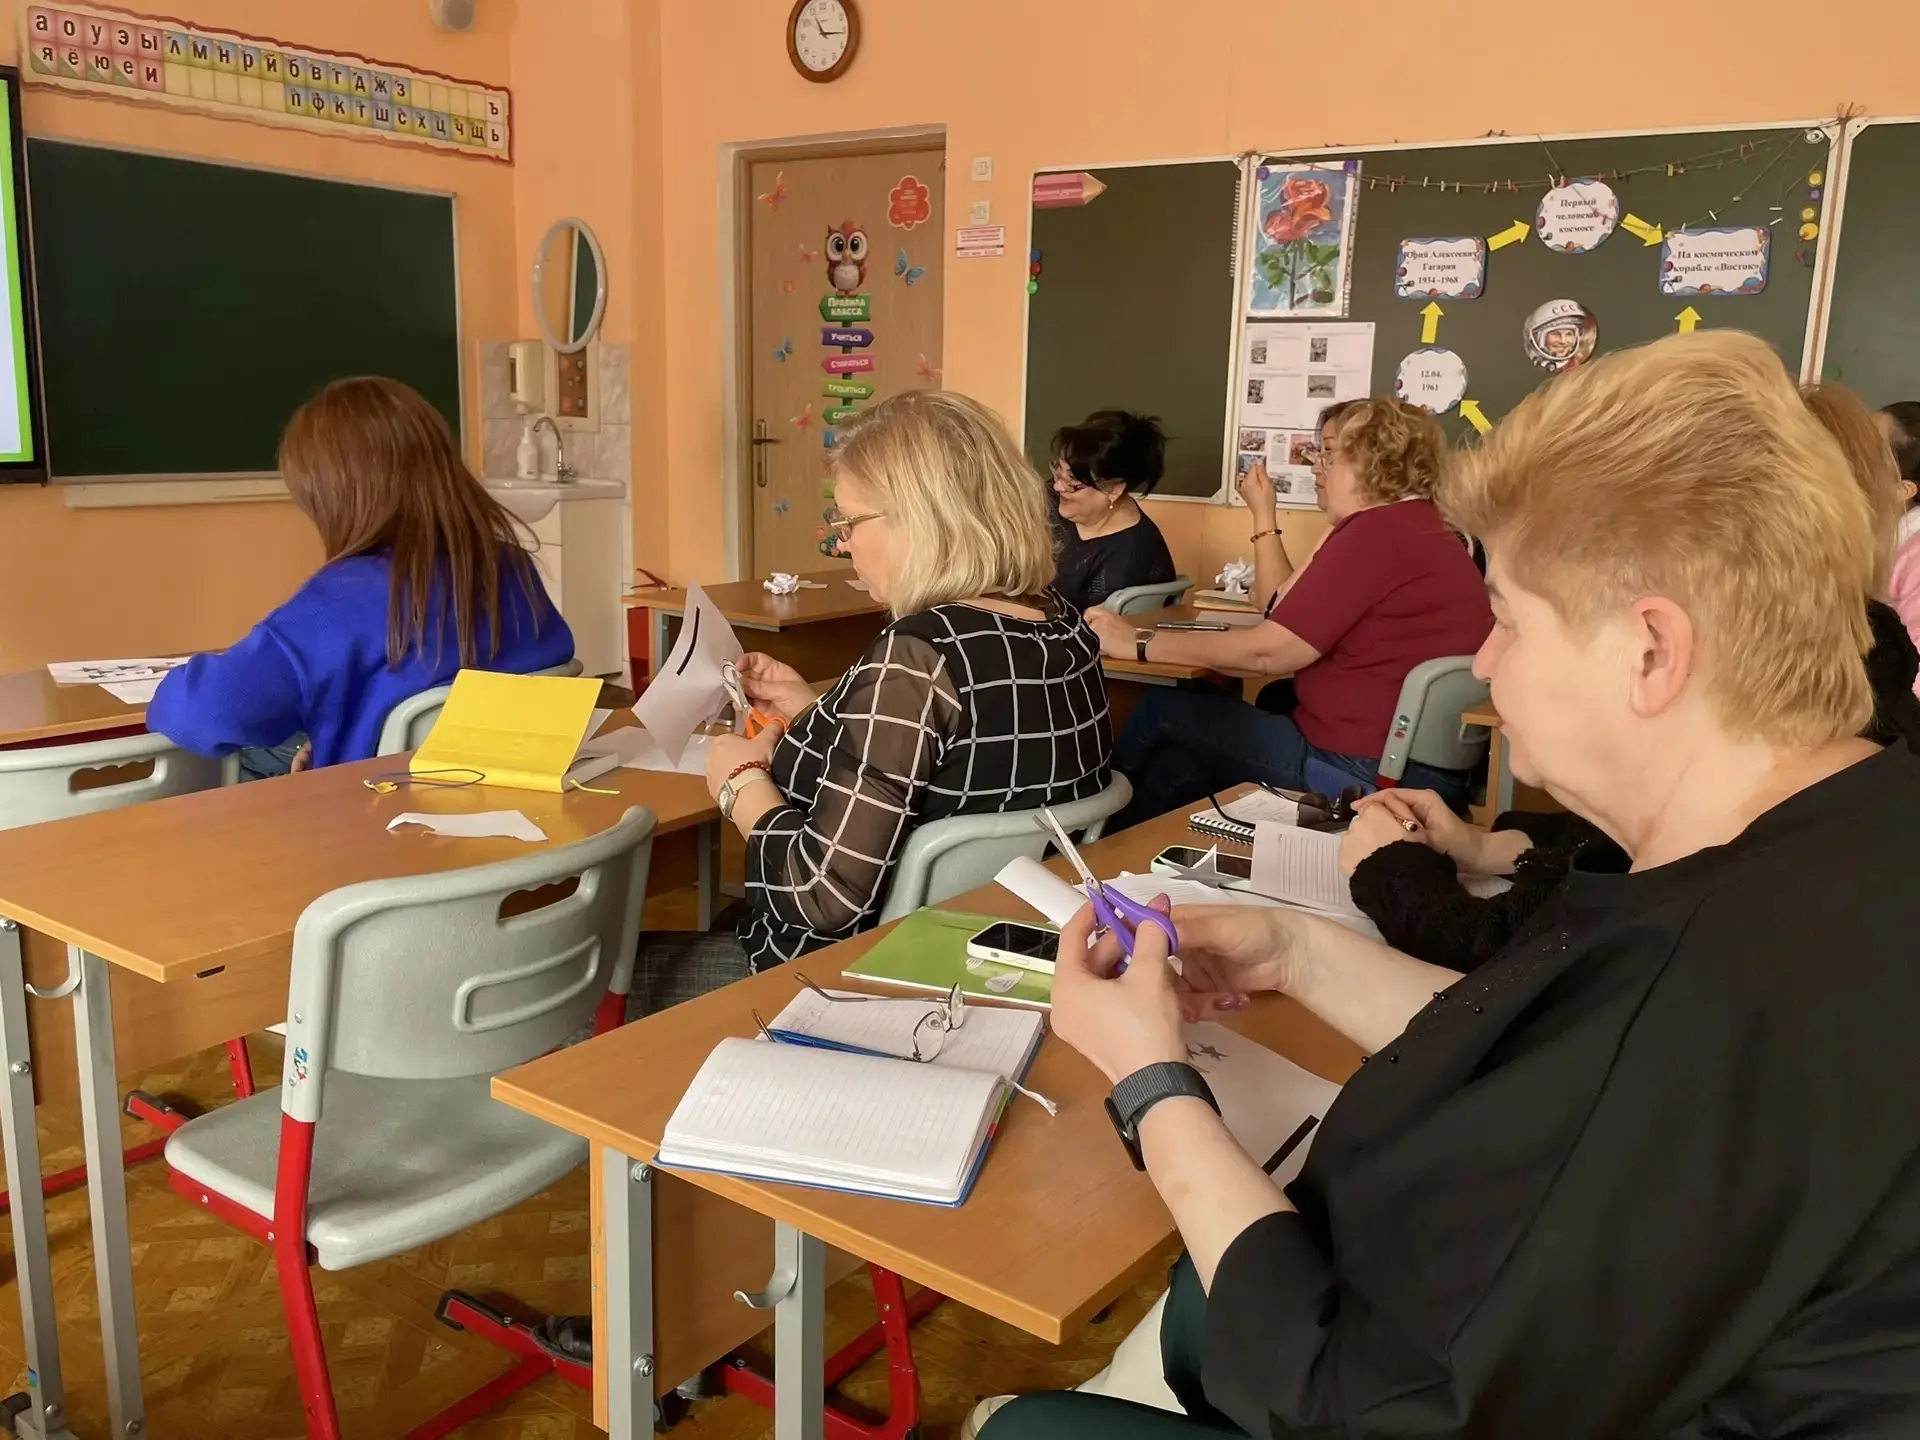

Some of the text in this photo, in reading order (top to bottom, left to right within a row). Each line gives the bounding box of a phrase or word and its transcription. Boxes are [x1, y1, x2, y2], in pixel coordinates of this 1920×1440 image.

[36, 15, 498, 115] а о у э ы л м н р й б в г д ж з ъ
[42, 47, 499, 142] я ё ю е и п ф к т ш с х ц ч щ ь
[1560, 198, 1597, 208] Первый
[1677, 249, 1758, 259] На космическом
[1423, 263, 1456, 272] Гагарин
[1673, 264, 1712, 274] корабле
[1422, 383, 1439, 391] 1961
